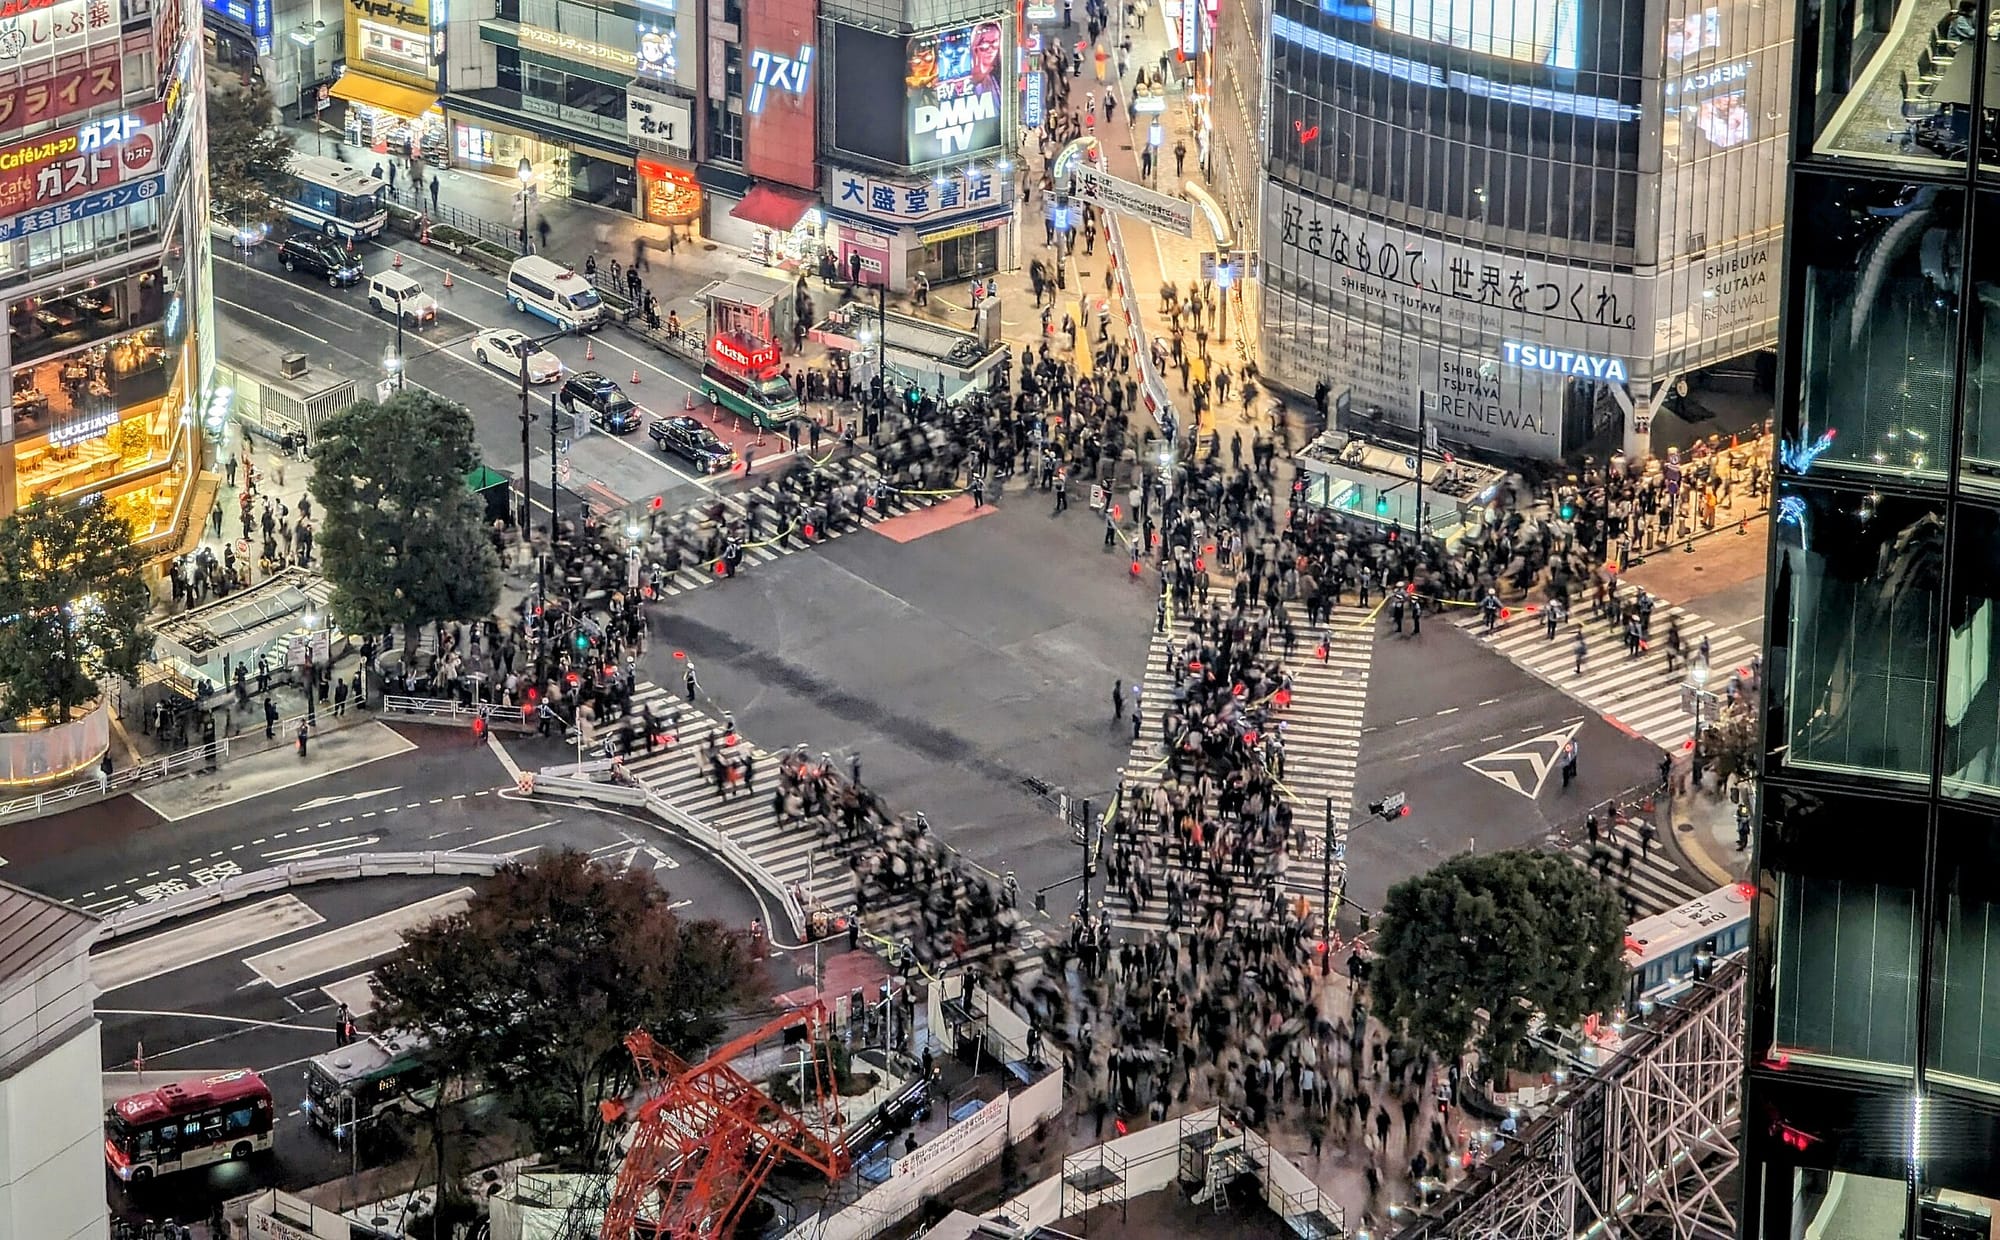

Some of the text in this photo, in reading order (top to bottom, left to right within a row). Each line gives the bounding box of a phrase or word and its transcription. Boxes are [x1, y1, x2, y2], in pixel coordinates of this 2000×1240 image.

[33, 1, 109, 43] しゃぶ葉
[749, 45, 811, 113] クスリ
[915, 92, 995, 134] DMM
[80, 115, 141, 152] ガスト
[936, 122, 974, 154] TV
[126, 147, 151, 161] ガスト
[0, 174, 32, 196] Café
[37, 153, 111, 201] ガスト
[139, 183, 156, 197] 6F
[842, 175, 991, 213] 大盛堂書店
[22, 190, 132, 233] 英会話イーオン
[1283, 203, 1635, 329] 好きなもので、世界をつくれ。
[1707, 250, 1767, 280] SHIBUYA
[1341, 277, 1387, 299] SHIBUYA
[1392, 293, 1441, 314] TSUTAYA
[1707, 271, 1766, 297] SUTAYA
[1504, 341, 1625, 381] TSUTAYA
[1443, 377, 1499, 399] TSUTAYA
[1441, 395, 1555, 436] RENEWAL.
